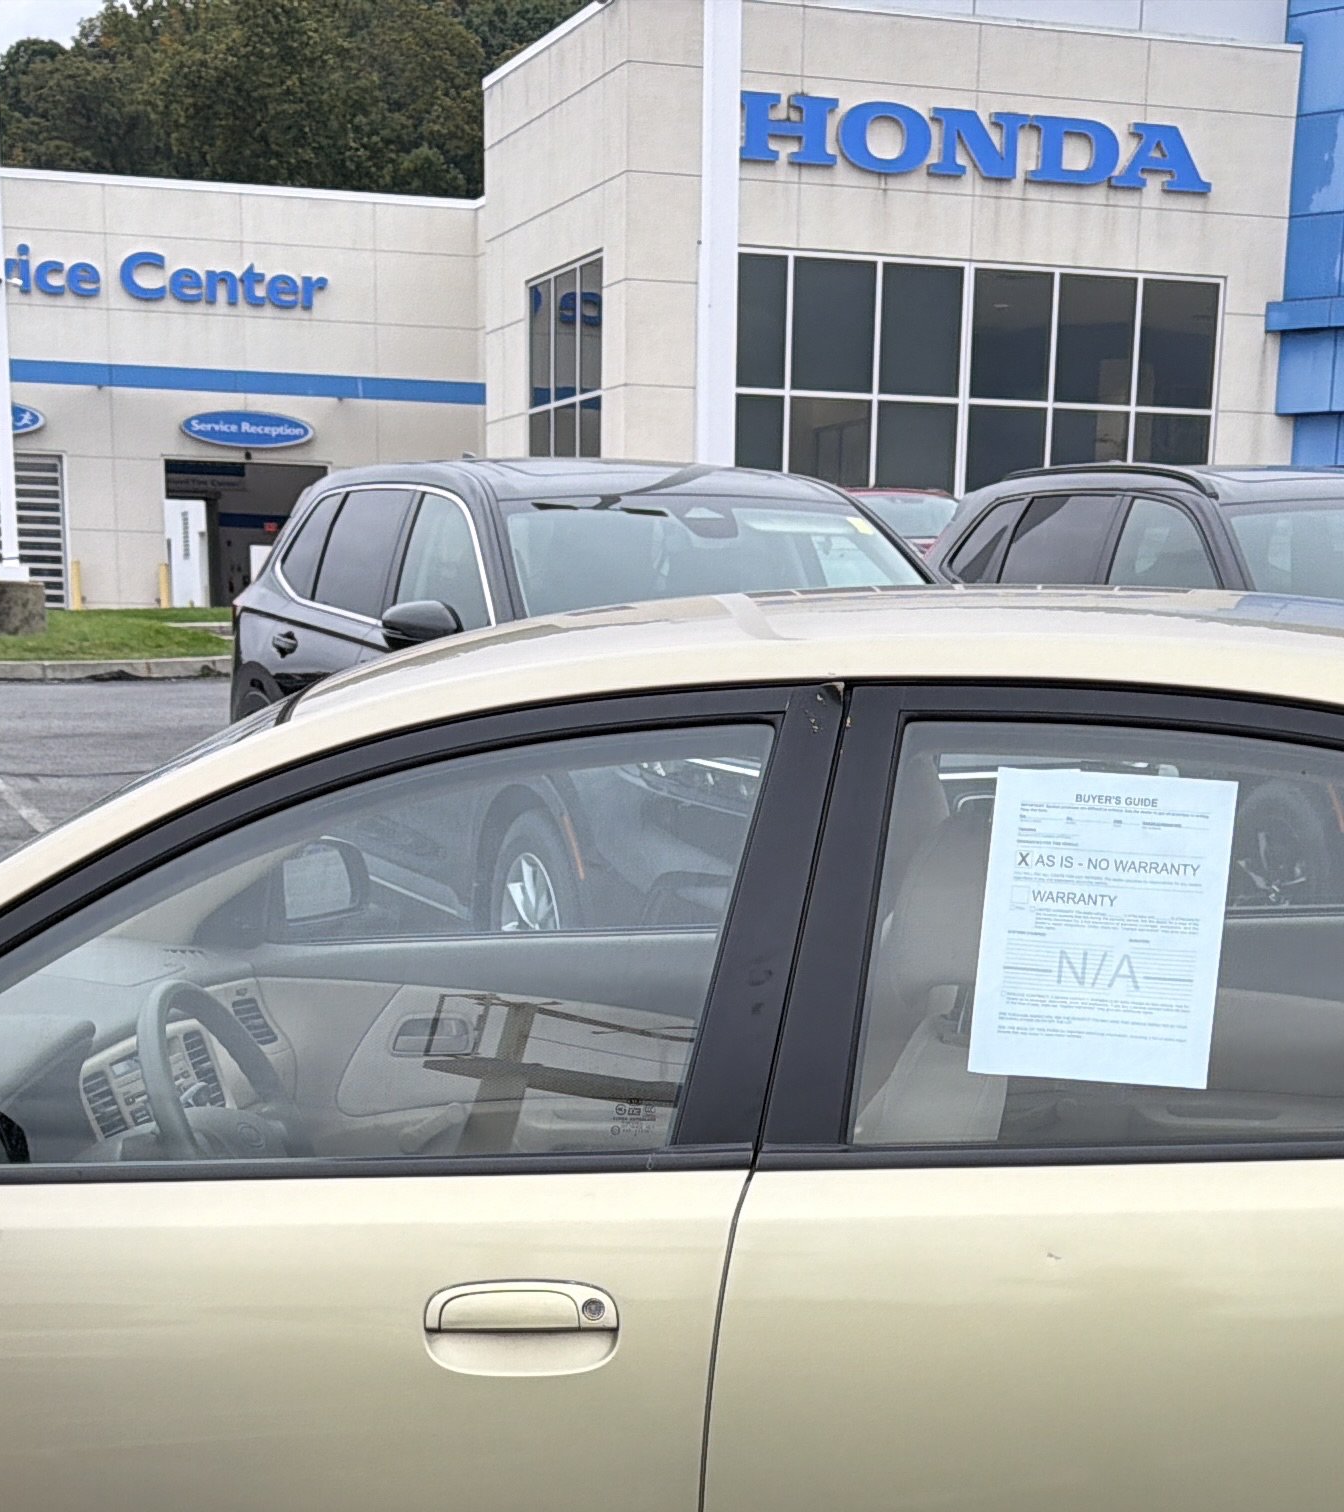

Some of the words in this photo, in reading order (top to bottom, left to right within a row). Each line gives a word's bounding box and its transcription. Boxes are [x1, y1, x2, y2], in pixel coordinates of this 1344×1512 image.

[740, 89, 1212, 193] HONDA
[120, 250, 328, 310] Center
[190, 419, 238, 433] Service
[240, 421, 305, 438] Reception
[1075, 793, 1122, 806] BUYER'S
[1124, 796, 1159, 808] GUIDE
[1017, 851, 1031, 867] X
[1034, 854, 1056, 868] AS
[1060, 855, 1074, 869] IS
[1087, 857, 1110, 871] NO
[1114, 859, 1201, 877] WARRANTY
[1032, 889, 1118, 907] WARRANTY
[1057, 949, 1140, 992] N/A
